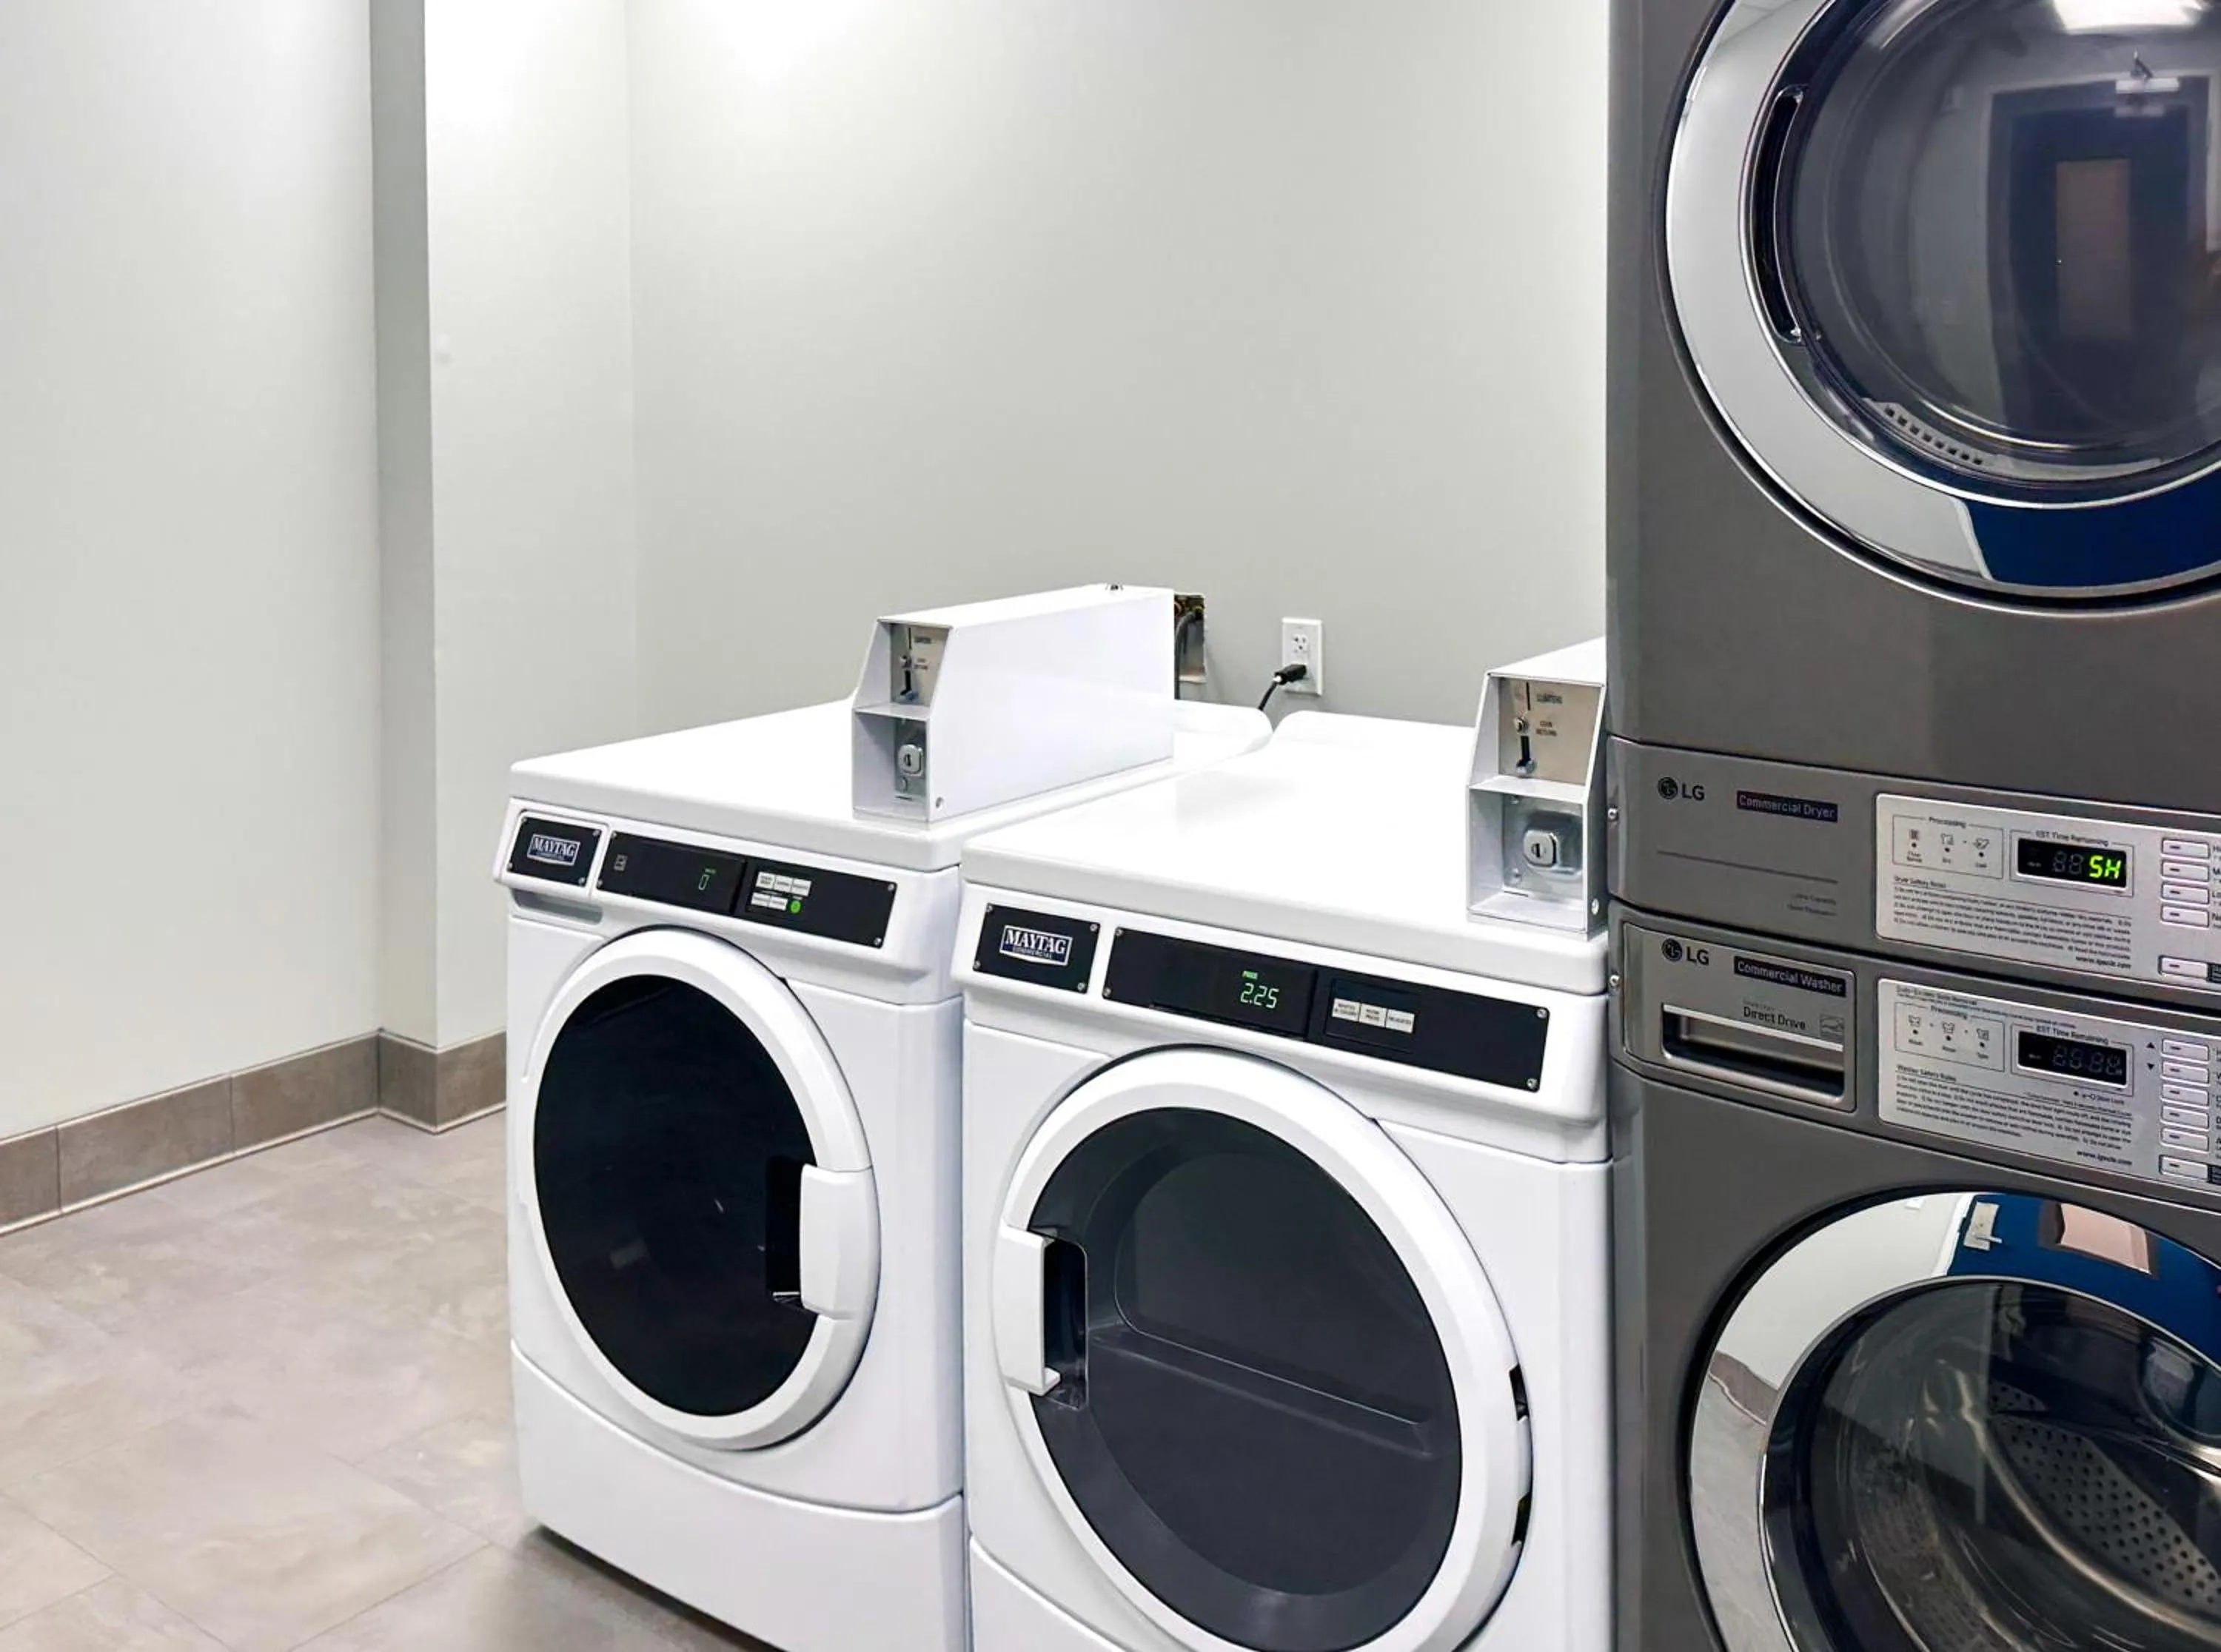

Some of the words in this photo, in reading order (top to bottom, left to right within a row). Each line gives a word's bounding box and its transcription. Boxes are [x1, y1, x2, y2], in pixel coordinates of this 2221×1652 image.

[1682, 783, 1704, 801] LG
[1740, 795, 1800, 813] Commercial
[1803, 804, 1835, 819] Dryer
[533, 837, 576, 856] MAYTAG
[1005, 929, 1067, 954] MAYTAG
[1686, 946, 1709, 966] LG
[1738, 961, 1798, 984] Commercial
[1800, 974, 1842, 993] Washer
[1240, 982, 1280, 1009] 2.25
[1743, 1007, 1775, 1023] Direct
[1778, 1013, 1806, 1031] Drive
